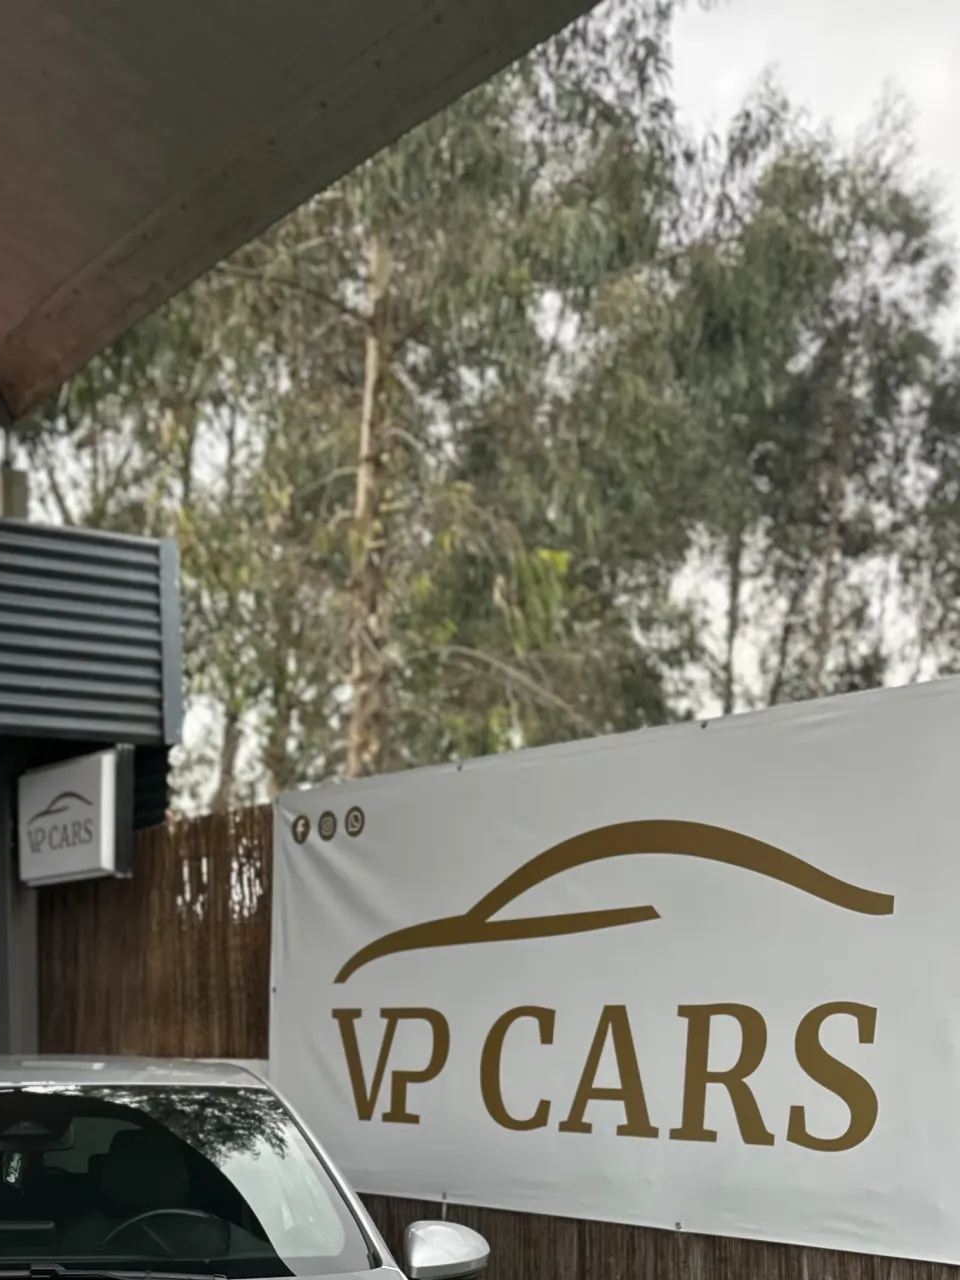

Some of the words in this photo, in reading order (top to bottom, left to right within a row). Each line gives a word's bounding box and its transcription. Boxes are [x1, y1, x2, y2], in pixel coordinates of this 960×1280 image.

[27, 827, 46, 854] VP
[48, 817, 93, 850] CARS
[332, 1007, 450, 1124] VP
[480, 1001, 879, 1152] CARS
